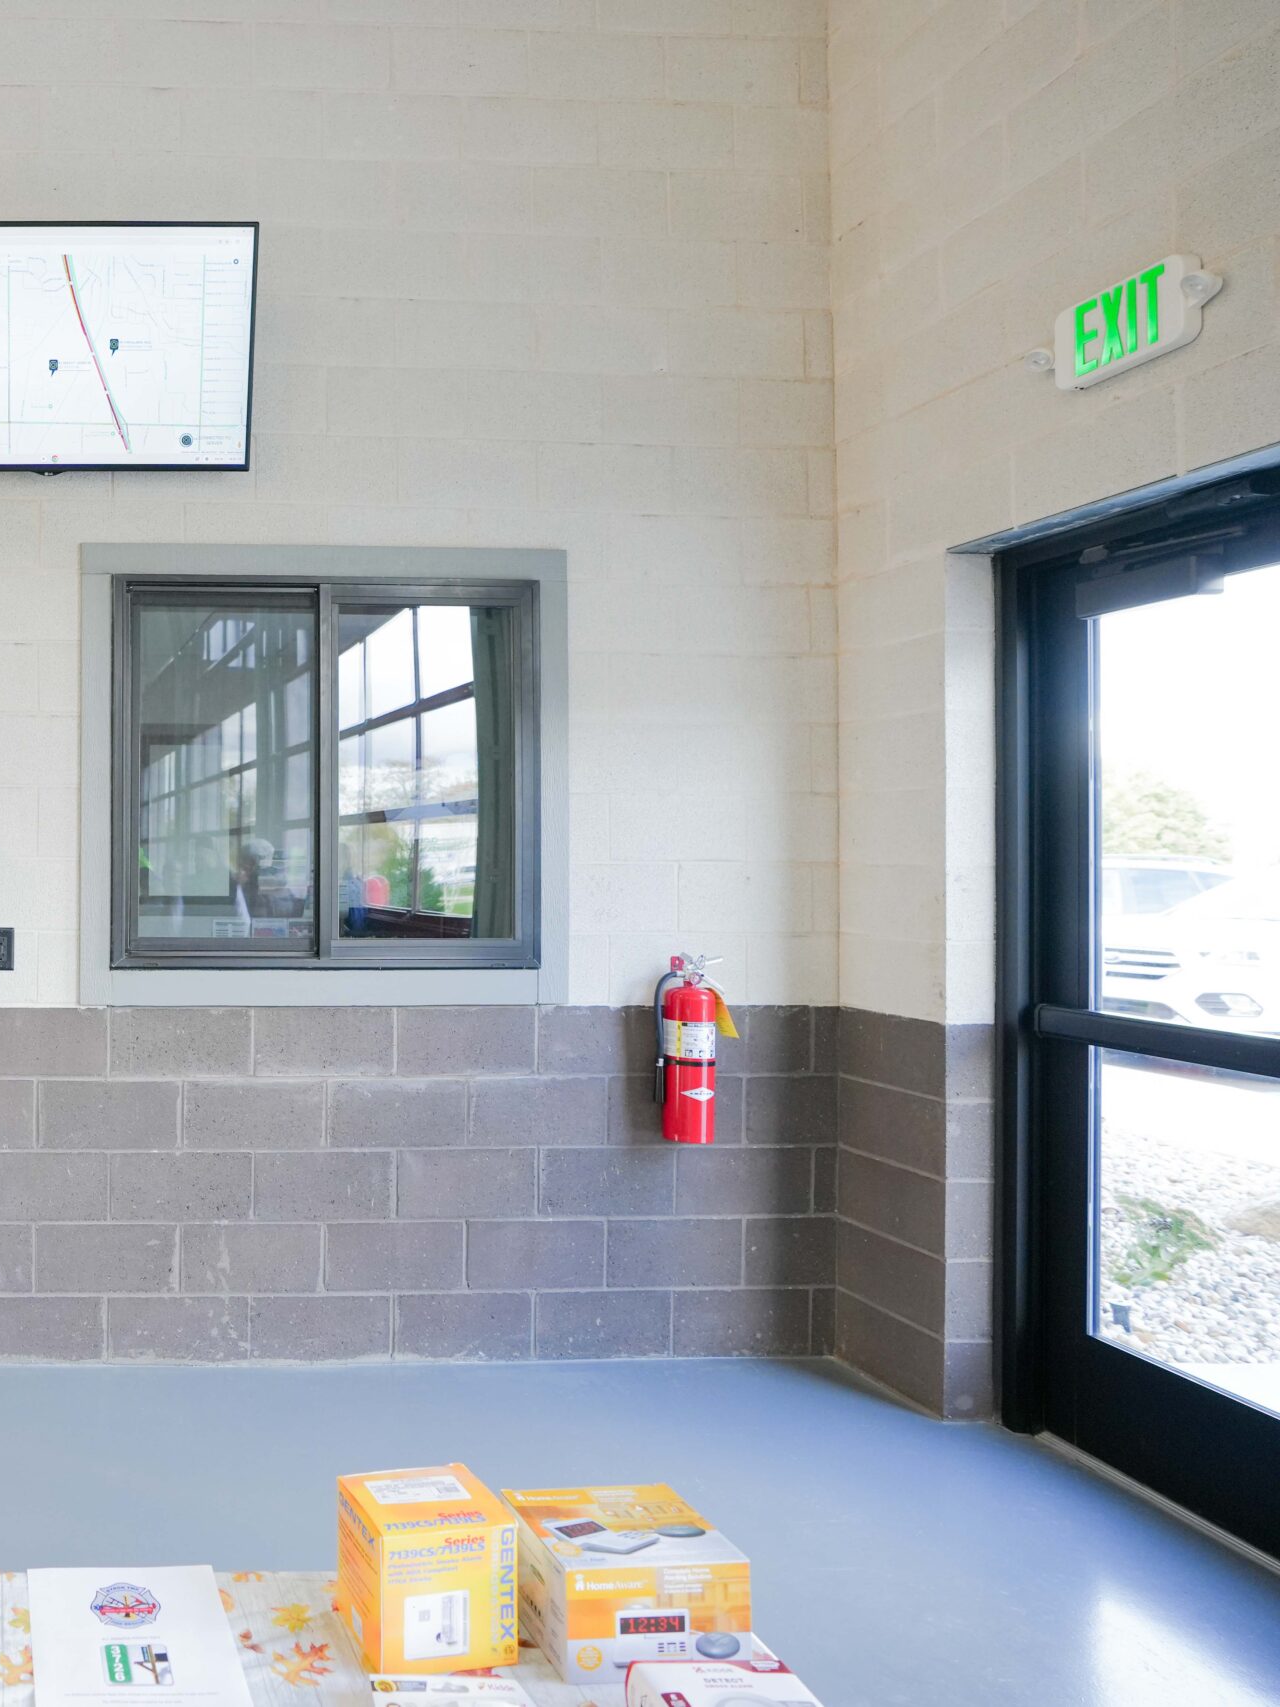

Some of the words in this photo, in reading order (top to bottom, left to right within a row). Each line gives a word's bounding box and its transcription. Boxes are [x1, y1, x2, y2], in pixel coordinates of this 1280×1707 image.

[1075, 264, 1165, 377] EXIT
[444, 1535, 486, 1546] Series
[500, 1527, 515, 1640] GENTEX
[586, 1579, 644, 1591] HomeAware
[628, 1617, 680, 1633] 12:34
[110, 1645, 126, 1682] 3726
